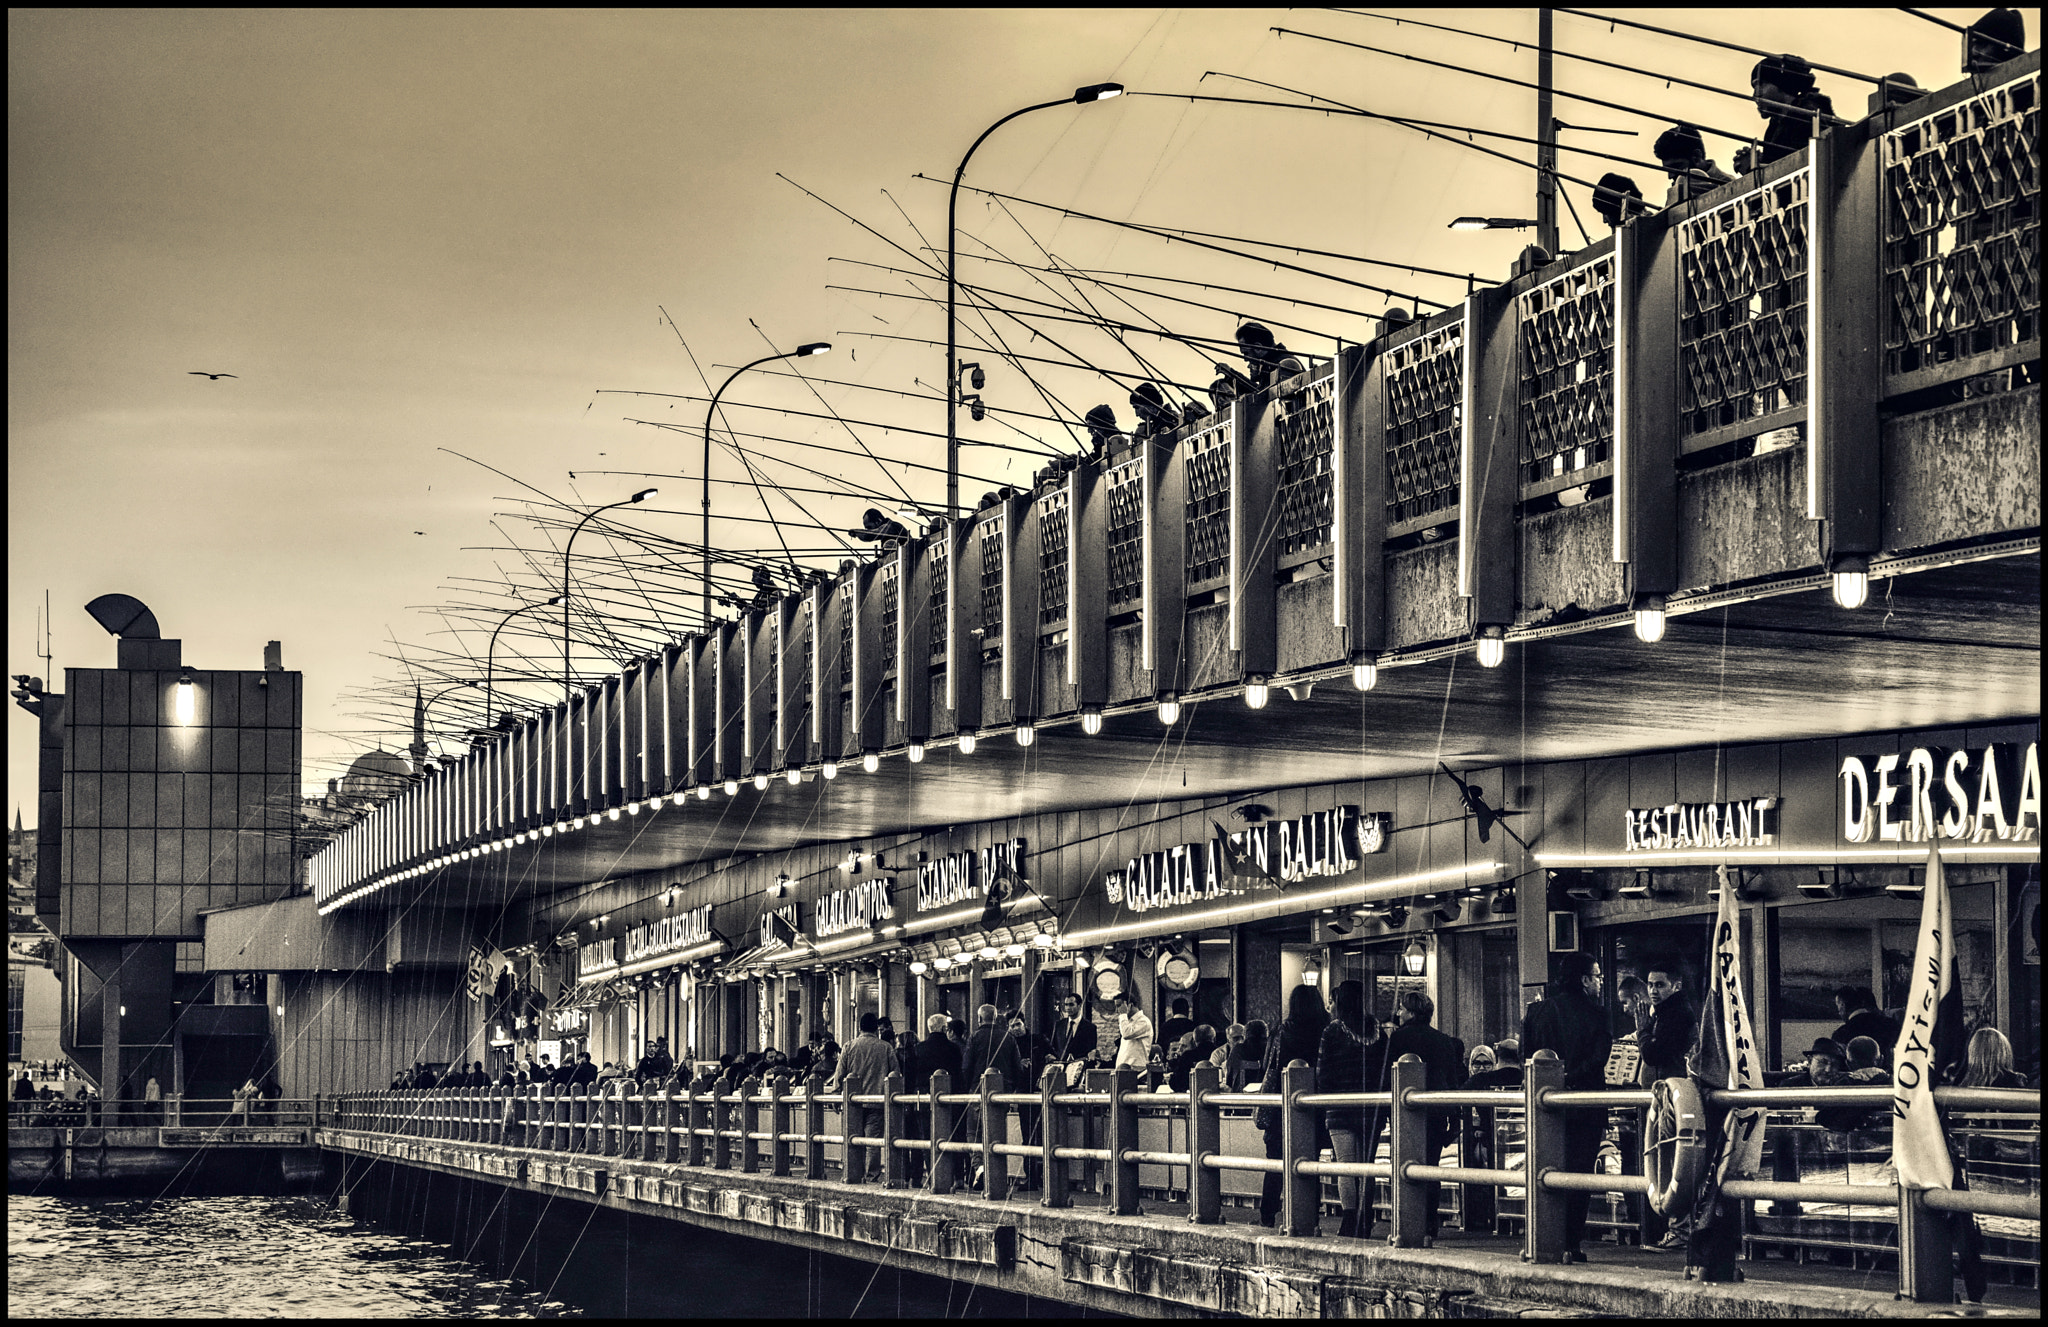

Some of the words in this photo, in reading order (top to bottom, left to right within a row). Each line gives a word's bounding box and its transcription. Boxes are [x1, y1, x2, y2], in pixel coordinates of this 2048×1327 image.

[1626, 798, 1775, 851] RESTAURANT
[1838, 743, 2041, 843] DERSAA
[1126, 843, 1202, 912] GALATA
[1280, 805, 1357, 882] BALIK
[816, 890, 846, 937] GALATA
[847, 878, 892, 929] OLYMPOS
